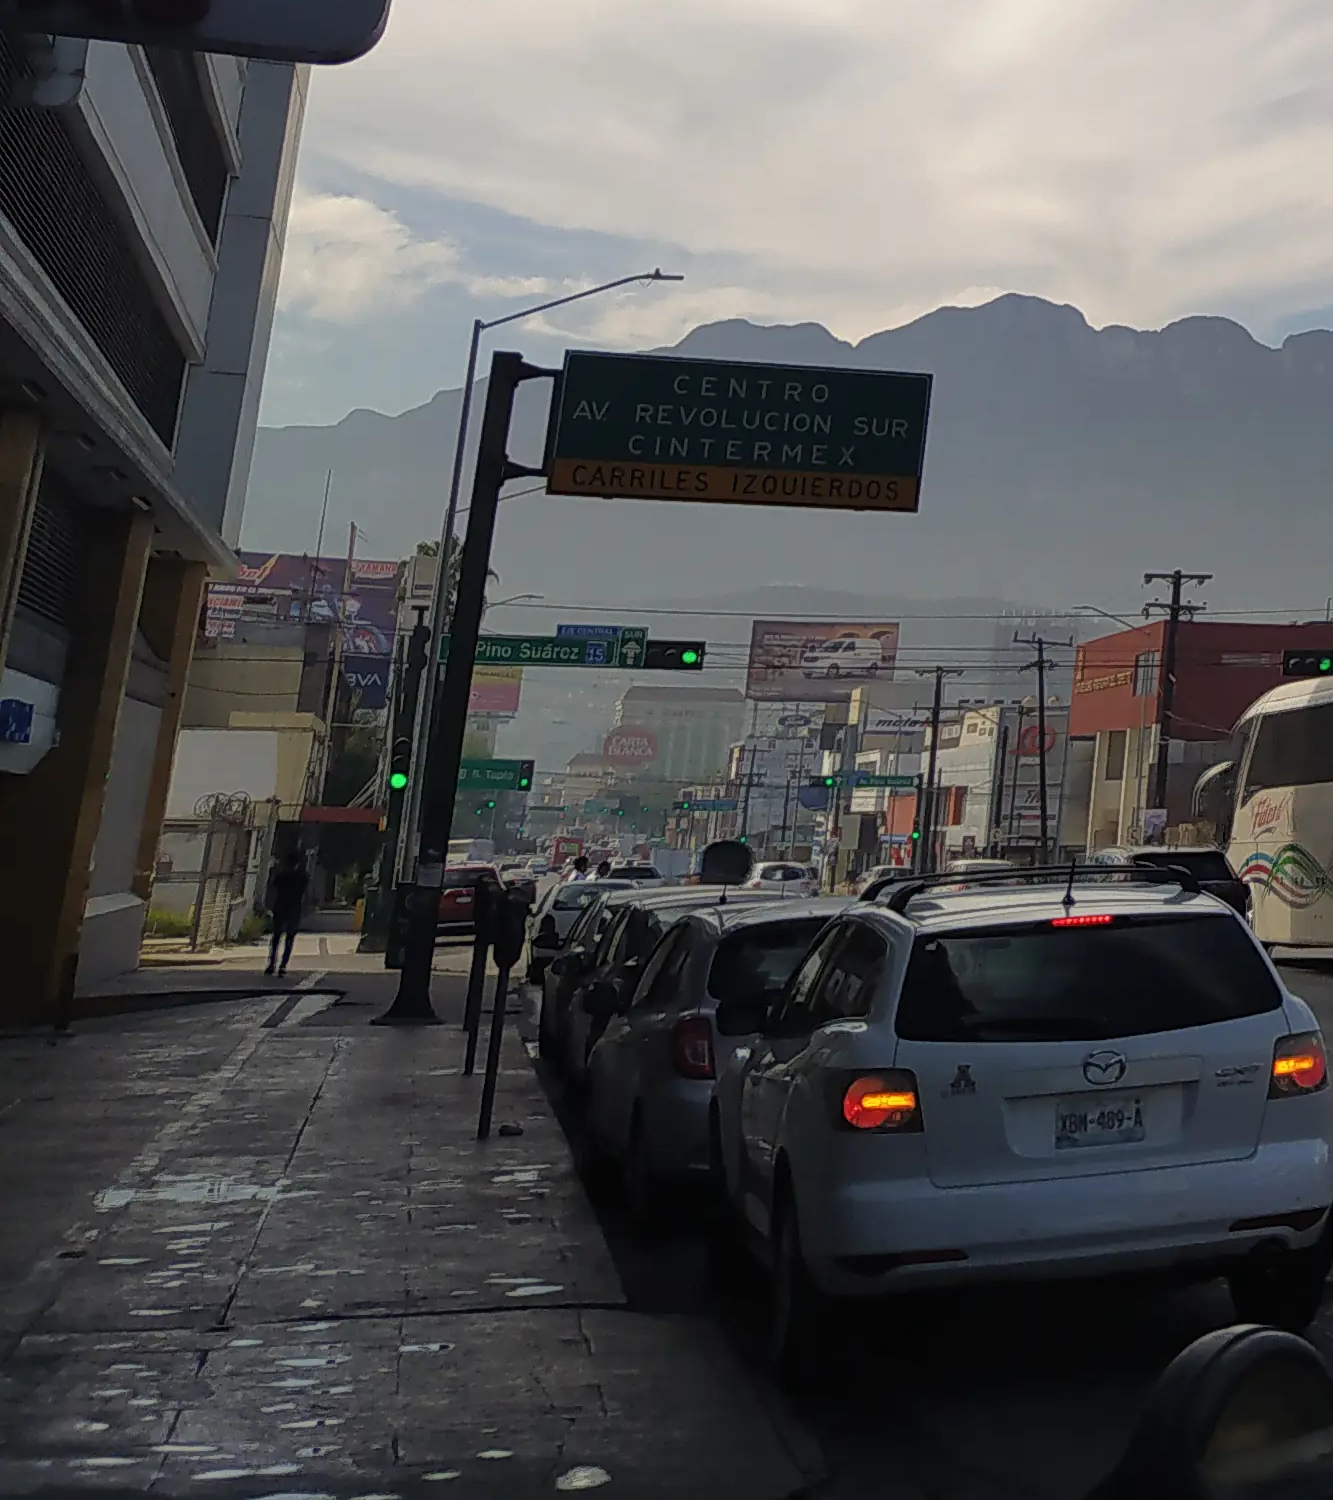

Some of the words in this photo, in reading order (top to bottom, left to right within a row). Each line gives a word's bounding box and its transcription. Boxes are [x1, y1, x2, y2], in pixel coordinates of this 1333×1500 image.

[673, 375, 829, 403] CENTRO
[635, 403, 833, 435] REVOLUCION
[853, 417, 909, 439] SUR
[628, 435, 856, 466] CINTERMEX
[572, 464, 709, 492] CARRILES
[731, 473, 900, 501] IZQUIERDOS
[475, 640, 511, 658] Pino
